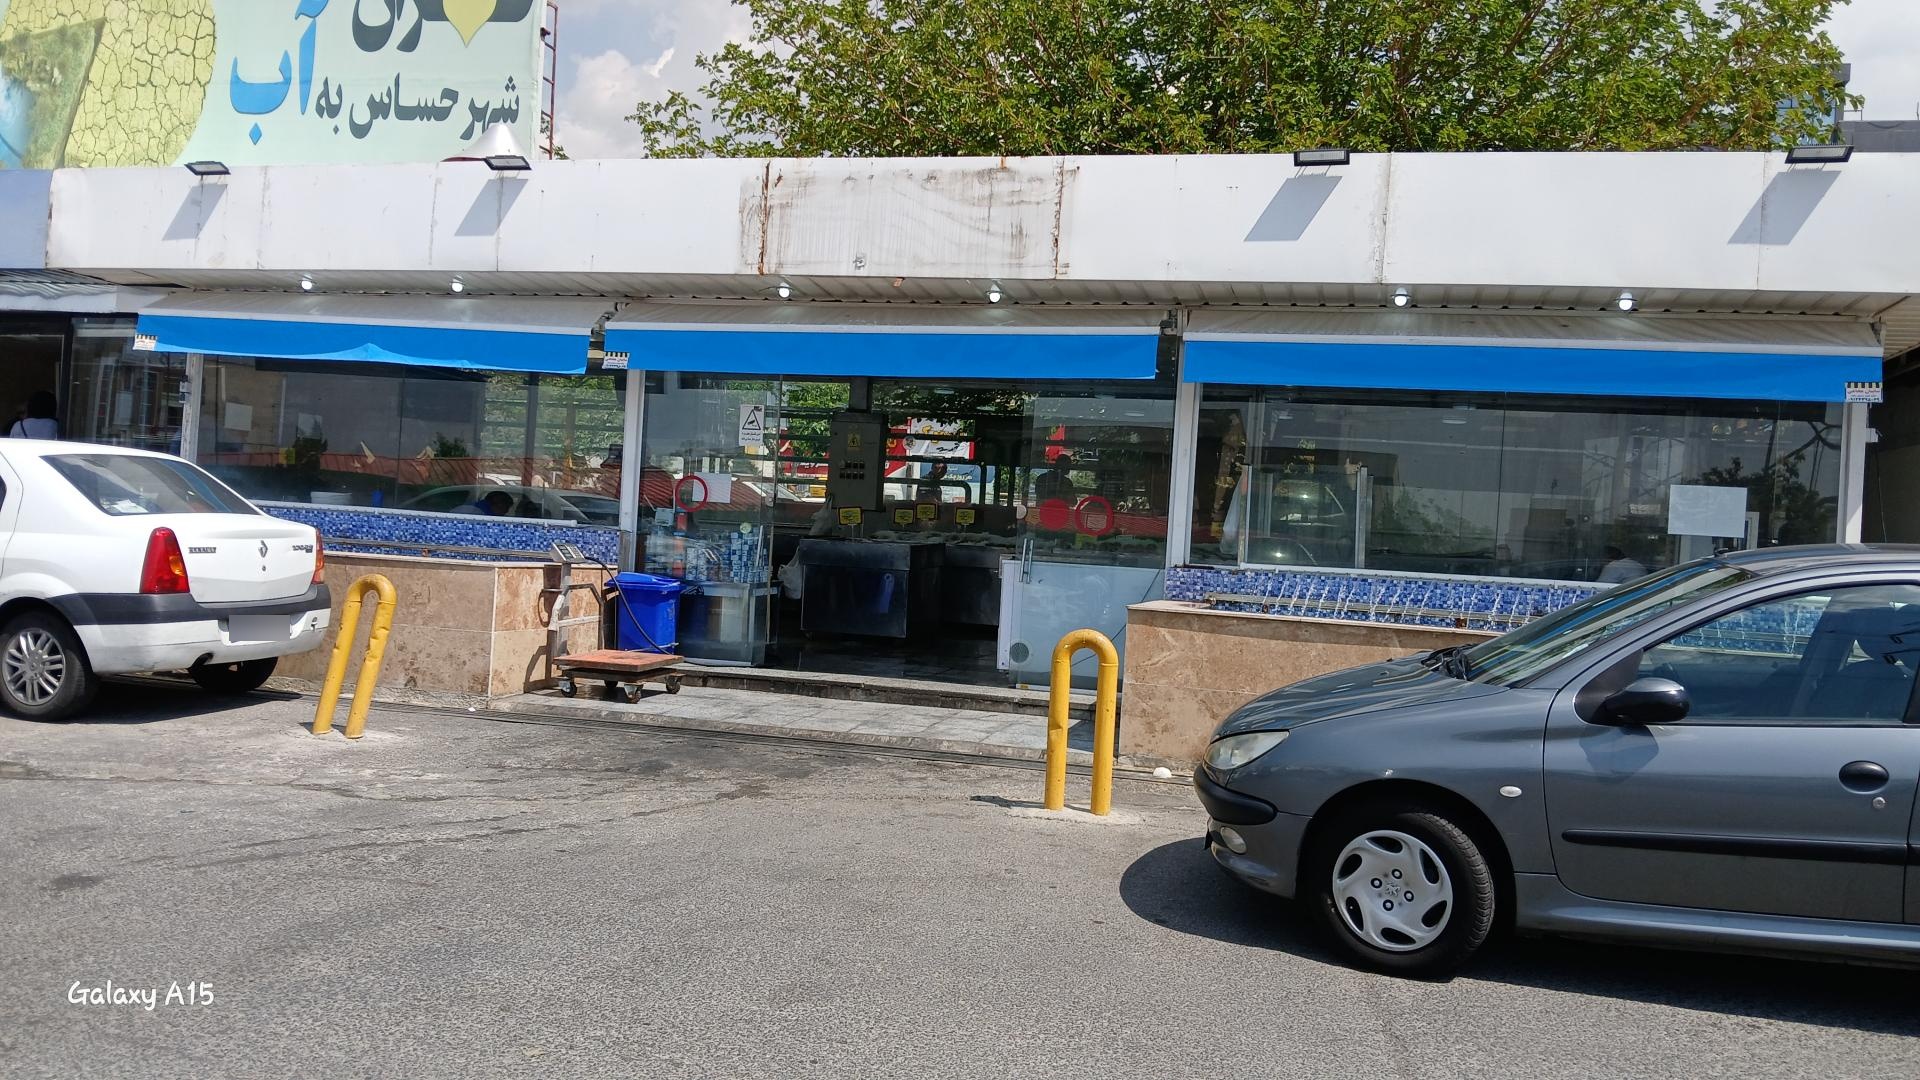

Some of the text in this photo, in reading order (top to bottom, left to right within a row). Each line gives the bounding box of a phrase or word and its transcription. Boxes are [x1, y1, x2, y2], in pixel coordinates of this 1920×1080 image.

[229, 0, 520, 146] شهر حساس به آب
